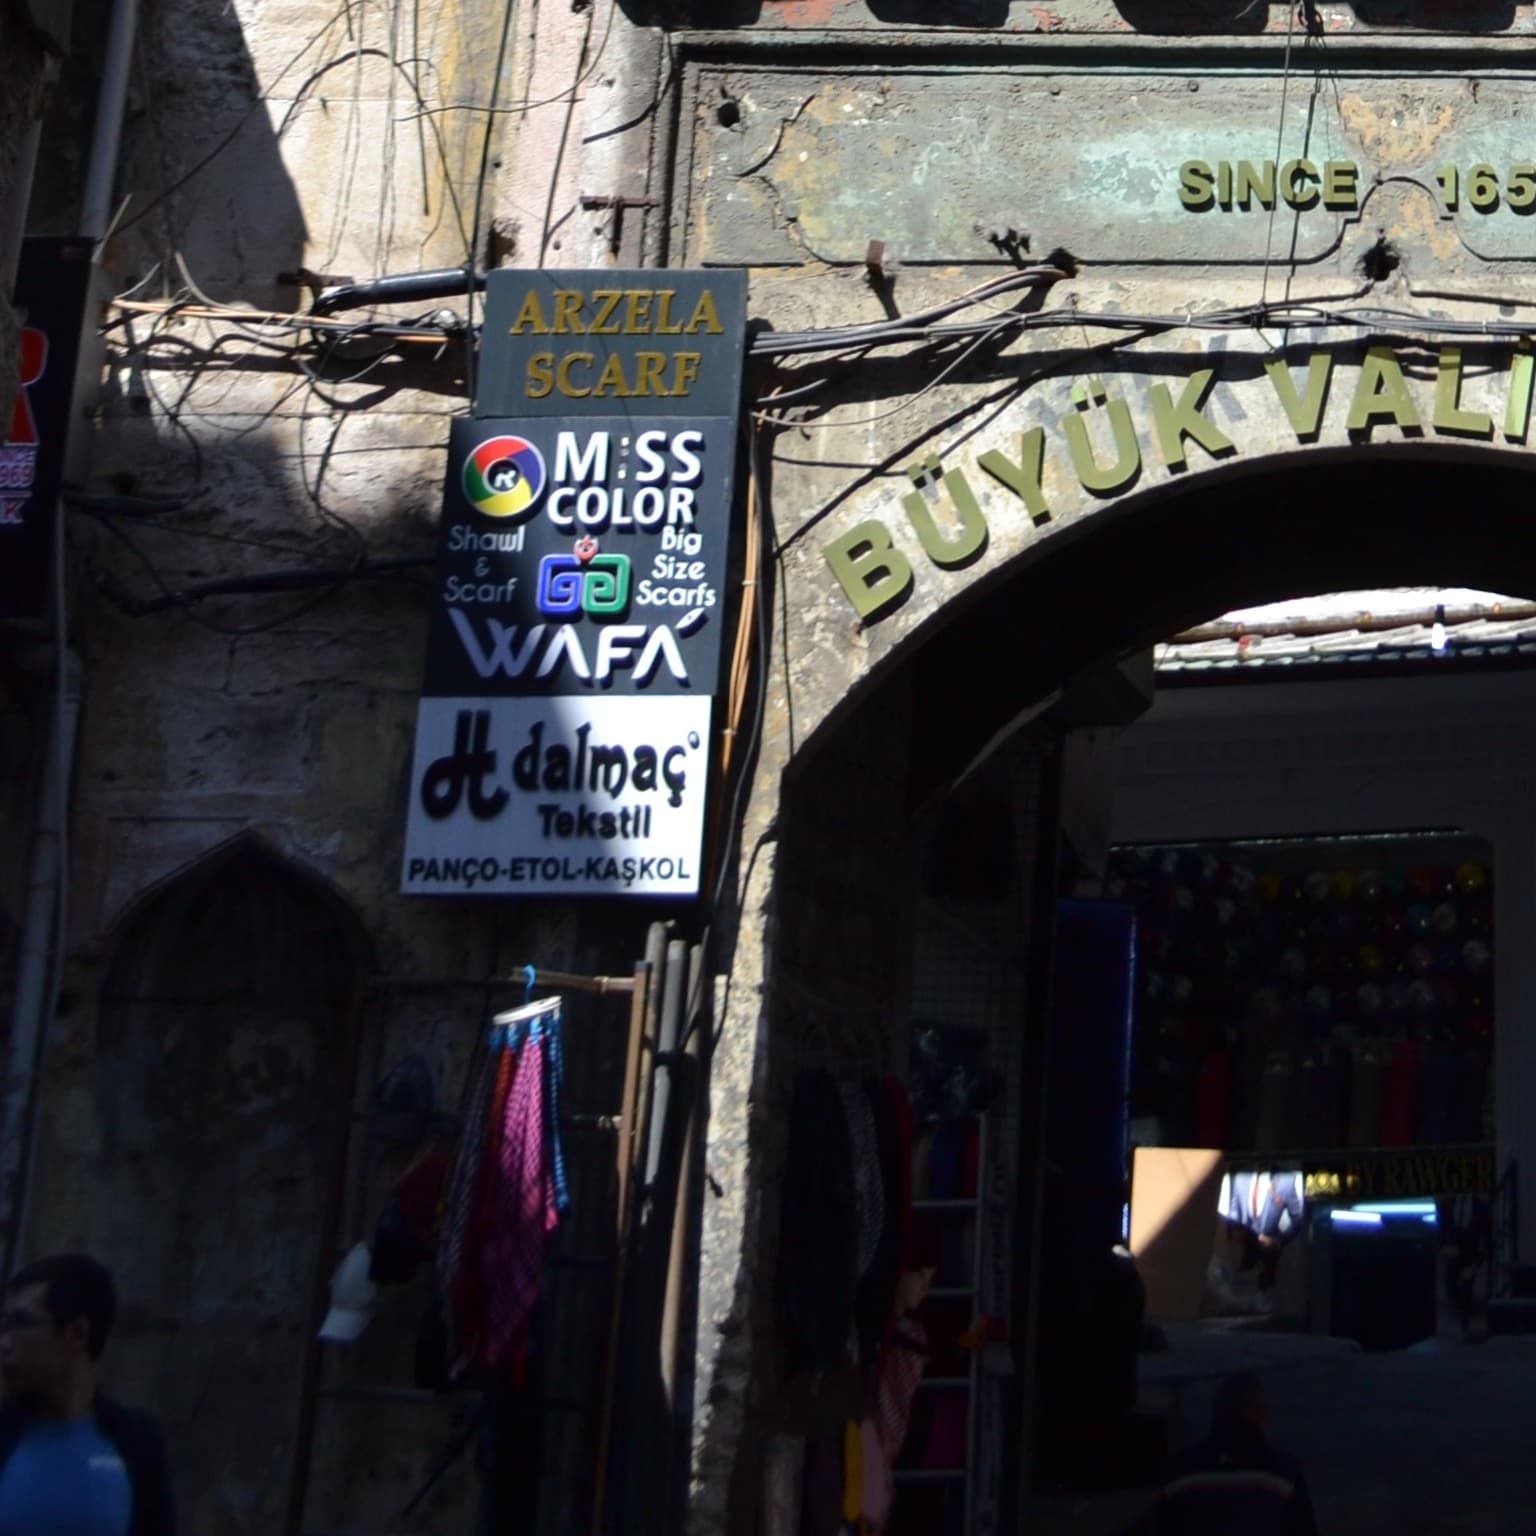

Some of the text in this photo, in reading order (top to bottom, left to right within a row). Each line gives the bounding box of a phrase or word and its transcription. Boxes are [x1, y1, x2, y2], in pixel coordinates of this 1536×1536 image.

[1177, 159, 1358, 209] SINCE
[509, 289, 724, 335] ARZELA
[524, 352, 701, 398] SCARF
[554, 430, 703, 482] MSS
[547, 486, 695, 526] COLOR
[822, 368, 1237, 622] BÜYÜK
[448, 524, 525, 552] Shawl
[660, 525, 703, 555] Big
[651, 554, 706, 580] Size
[443, 576, 518, 603] Scarf
[635, 580, 717, 607] Scarfs
[512, 719, 687, 808] dalmaç
[537, 803, 652, 840] Tekstil
